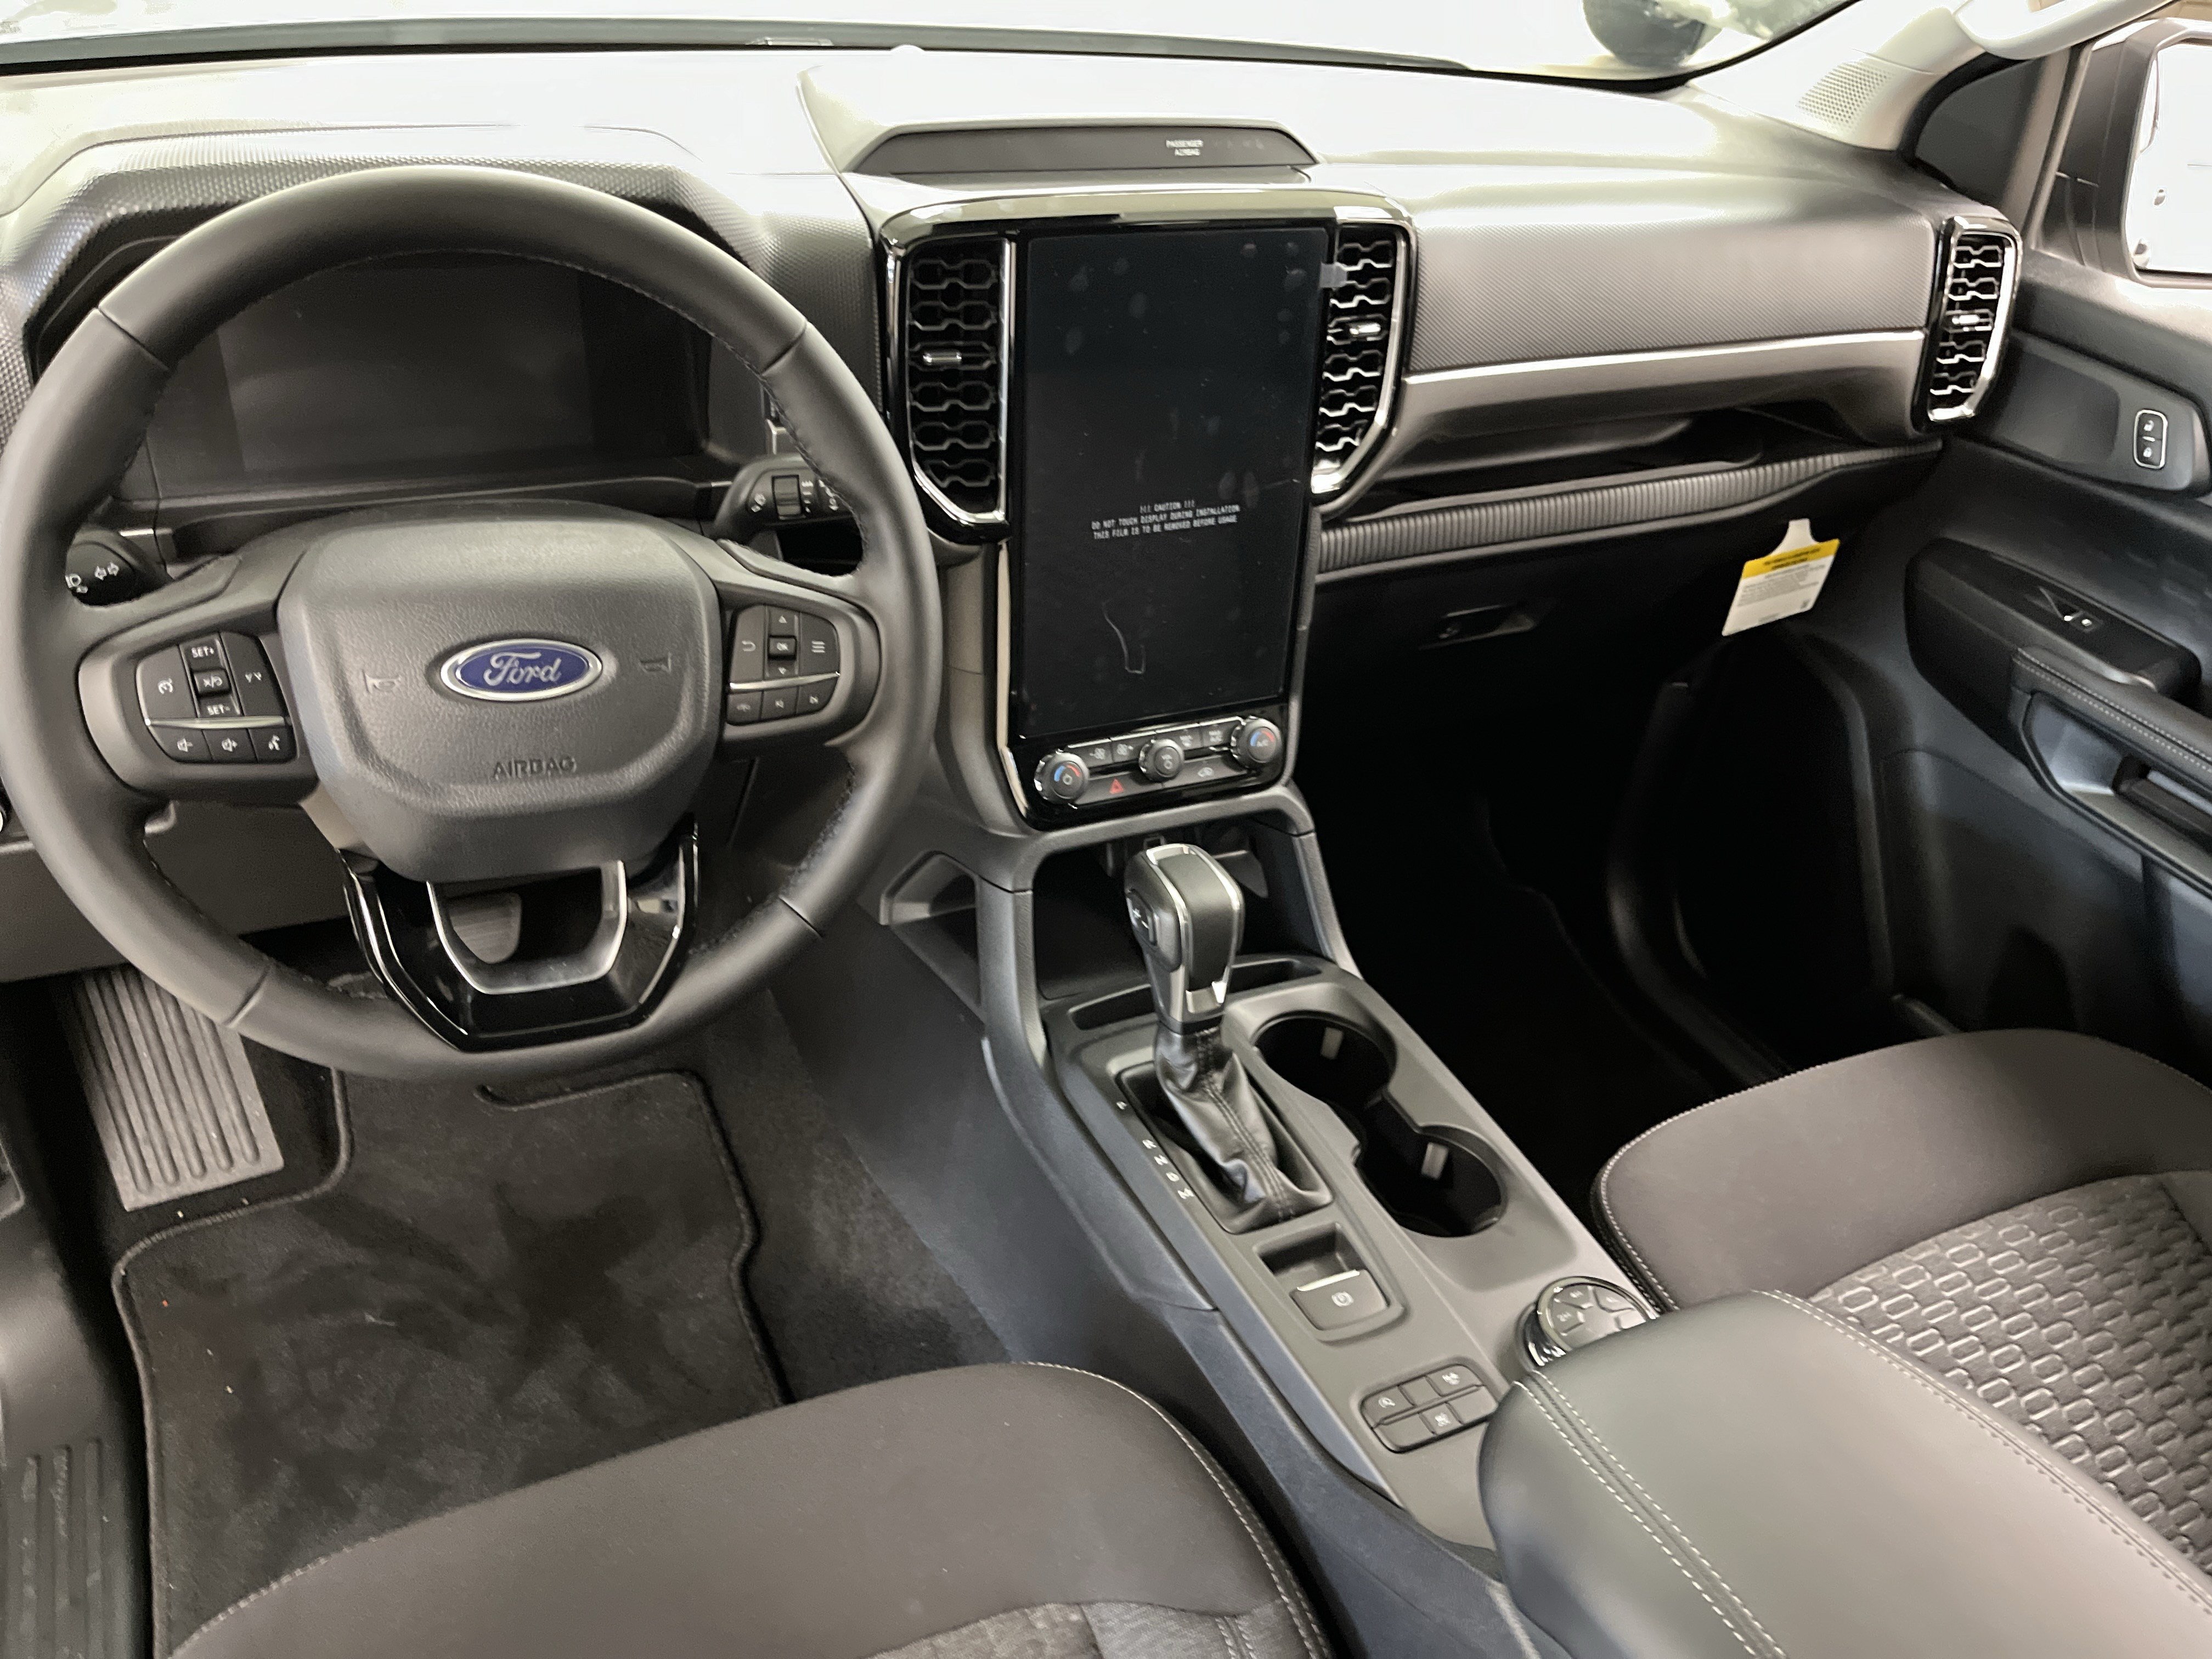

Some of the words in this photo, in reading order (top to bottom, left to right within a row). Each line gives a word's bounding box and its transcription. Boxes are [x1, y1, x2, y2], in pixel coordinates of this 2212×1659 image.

[1166, 139, 1203, 148] PASSENGER
[1154, 501, 1181, 511] CAUTION
[1091, 521, 1101, 530] DO
[1103, 519, 1115, 528] NOT
[1118, 517, 1138, 526] TOUCH
[1140, 513, 1167, 524] DISPLAY
[1170, 510, 1193, 520] DURING
[1196, 504, 1240, 517] INSTALLATION
[1093, 530, 1109, 539] THIS
[1131, 527, 1139, 535] IS
[1142, 525, 1150, 533] TO
[1153, 523, 1161, 532] BE
[483, 652, 562, 686] Ford
[493, 756, 577, 781] AIRBAG
[1142, 1139, 1156, 1149] R
[1154, 1154, 1169, 1165] N
[1166, 1172, 1180, 1182] D
[1178, 1188, 1194, 1199] M
